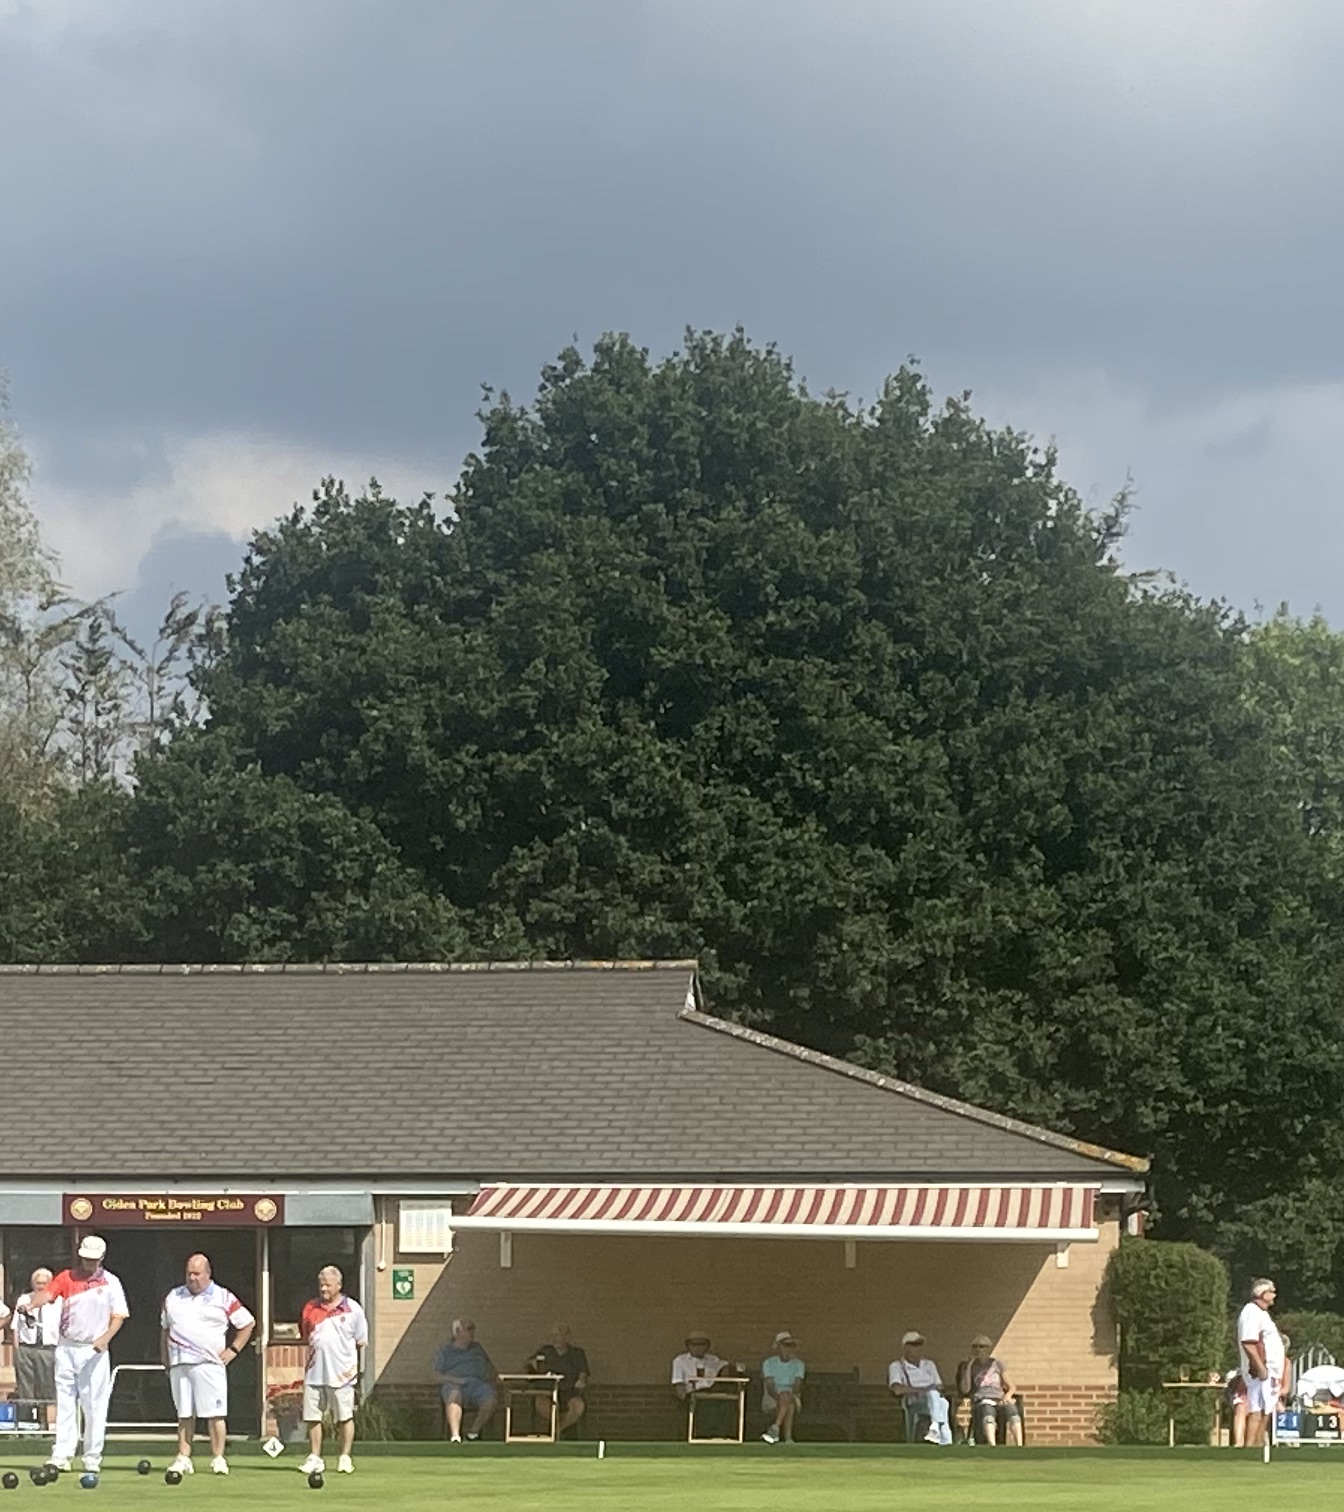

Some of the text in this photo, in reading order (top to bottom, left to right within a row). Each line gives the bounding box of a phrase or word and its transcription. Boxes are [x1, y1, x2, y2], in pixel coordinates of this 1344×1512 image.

[138, 1199, 166, 1210] Park
[168, 1199, 215, 1212] Bowling
[217, 1199, 245, 1210] Club
[145, 1212, 181, 1221] Founded
[1277, 1415, 1298, 1427] 21
[1317, 1415, 1338, 1428] 13
[268, 1440, 278, 1453] 4
